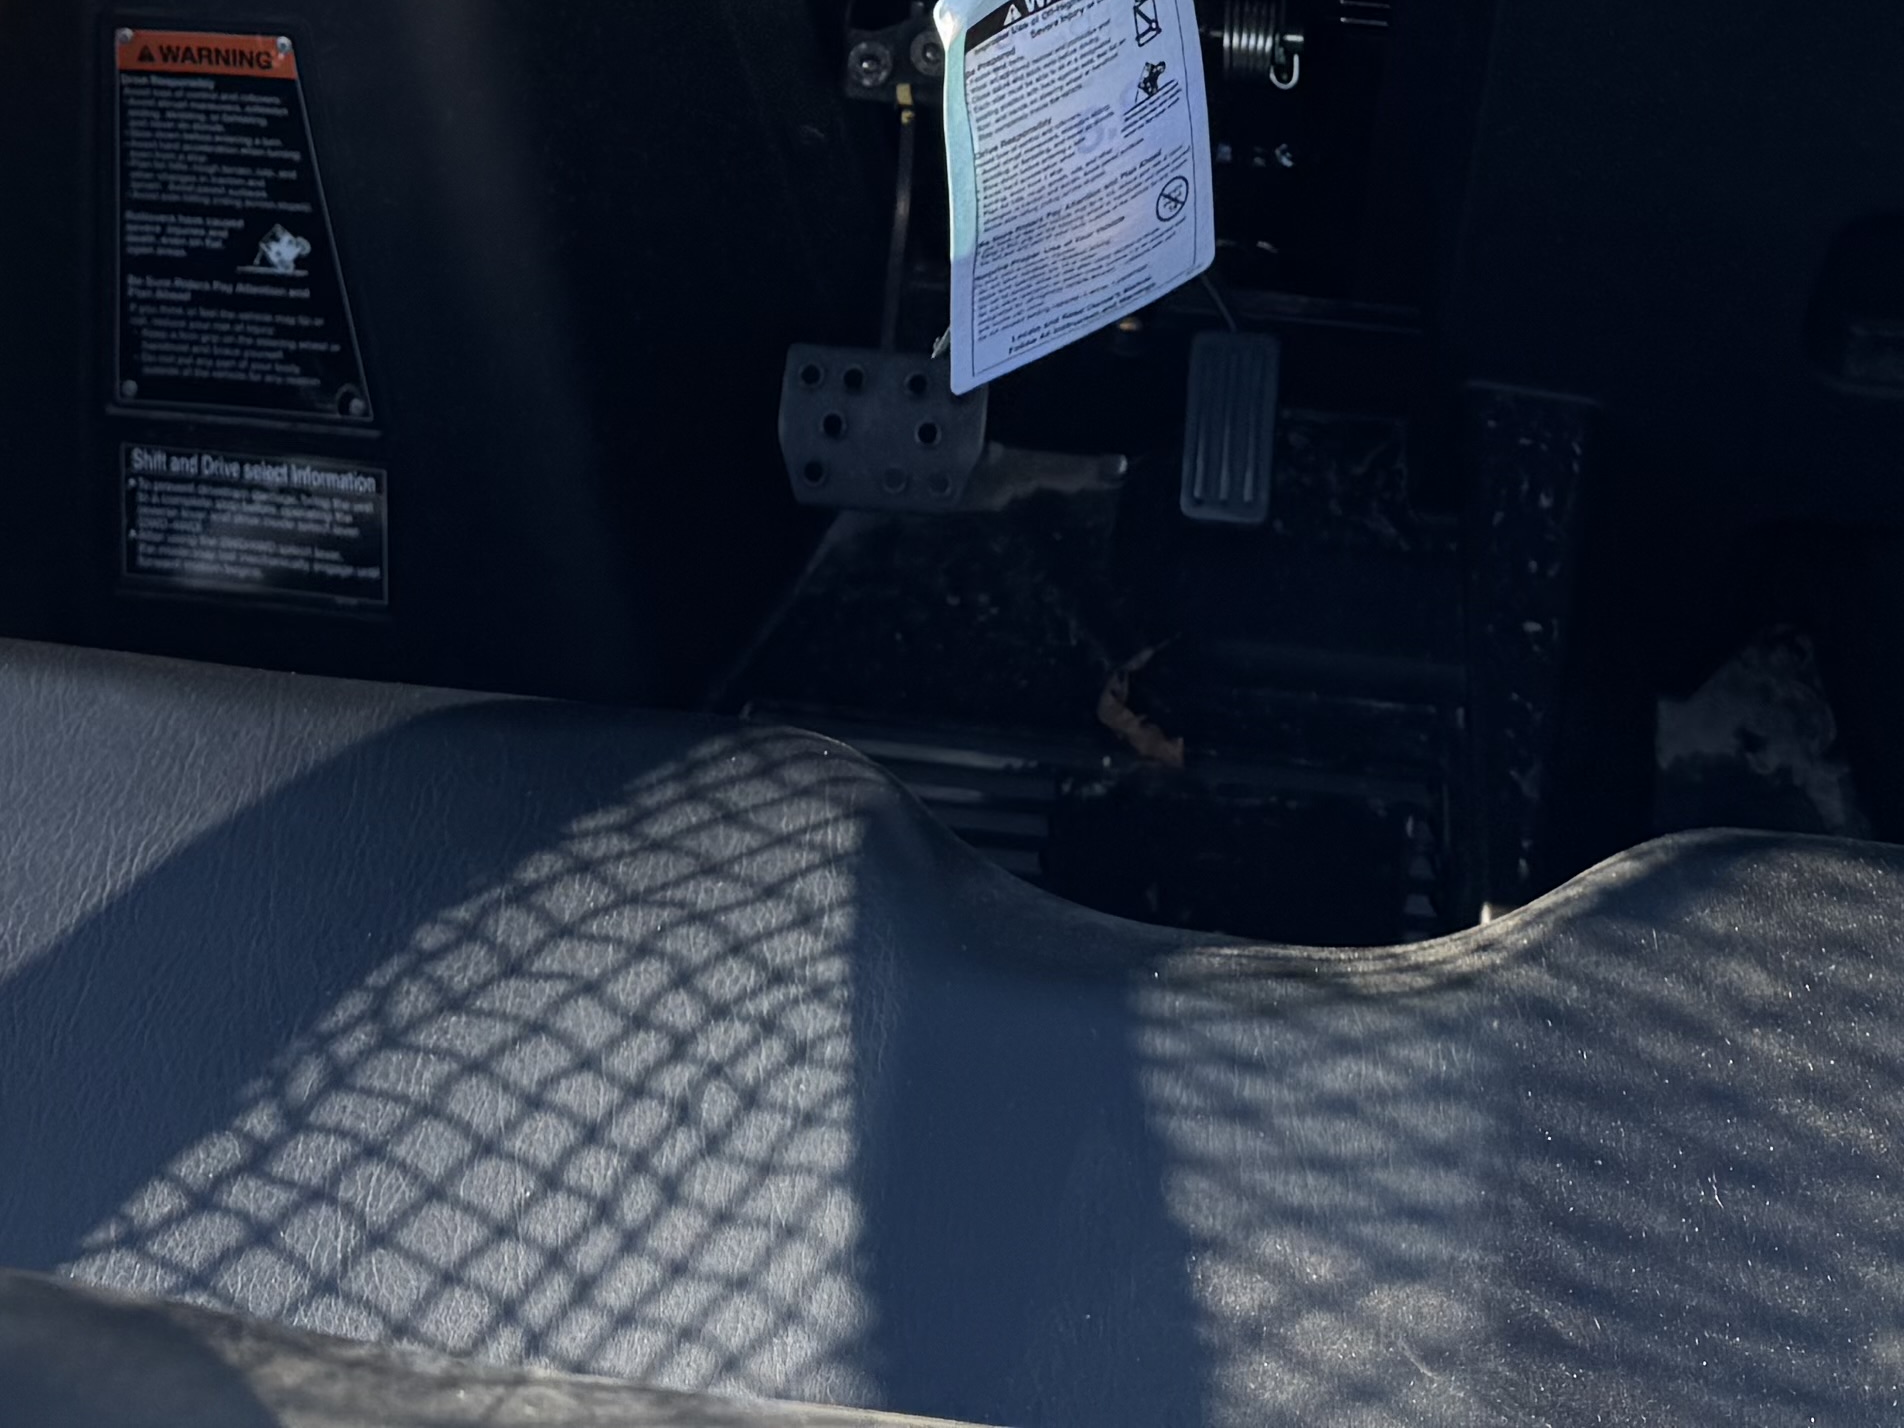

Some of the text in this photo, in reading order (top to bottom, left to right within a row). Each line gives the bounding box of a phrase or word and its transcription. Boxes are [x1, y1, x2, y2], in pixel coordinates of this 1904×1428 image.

[159, 45, 273, 70] WARNING
[131, 447, 167, 472] Shift
[170, 454, 198, 476] and
[201, 454, 241, 478] Drive
[291, 464, 377, 493] Information
